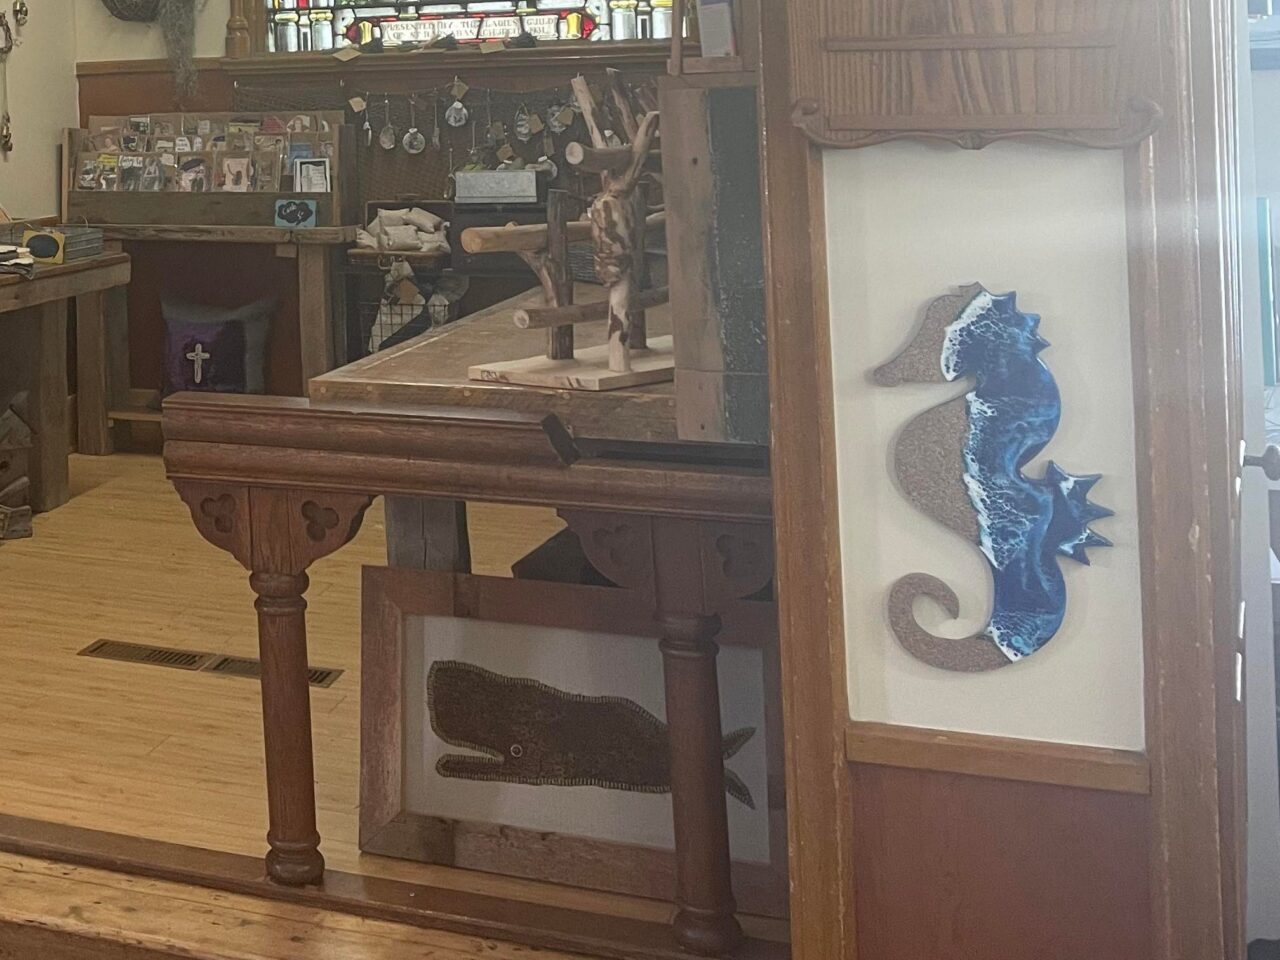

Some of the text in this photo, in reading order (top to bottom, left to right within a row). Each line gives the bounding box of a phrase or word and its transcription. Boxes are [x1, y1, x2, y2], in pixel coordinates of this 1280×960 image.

[384, 20, 435, 32] PRESENTED
[462, 19, 480, 29] THE
[485, 17, 519, 28] LADIES
[526, 16, 554, 27] GUILD
